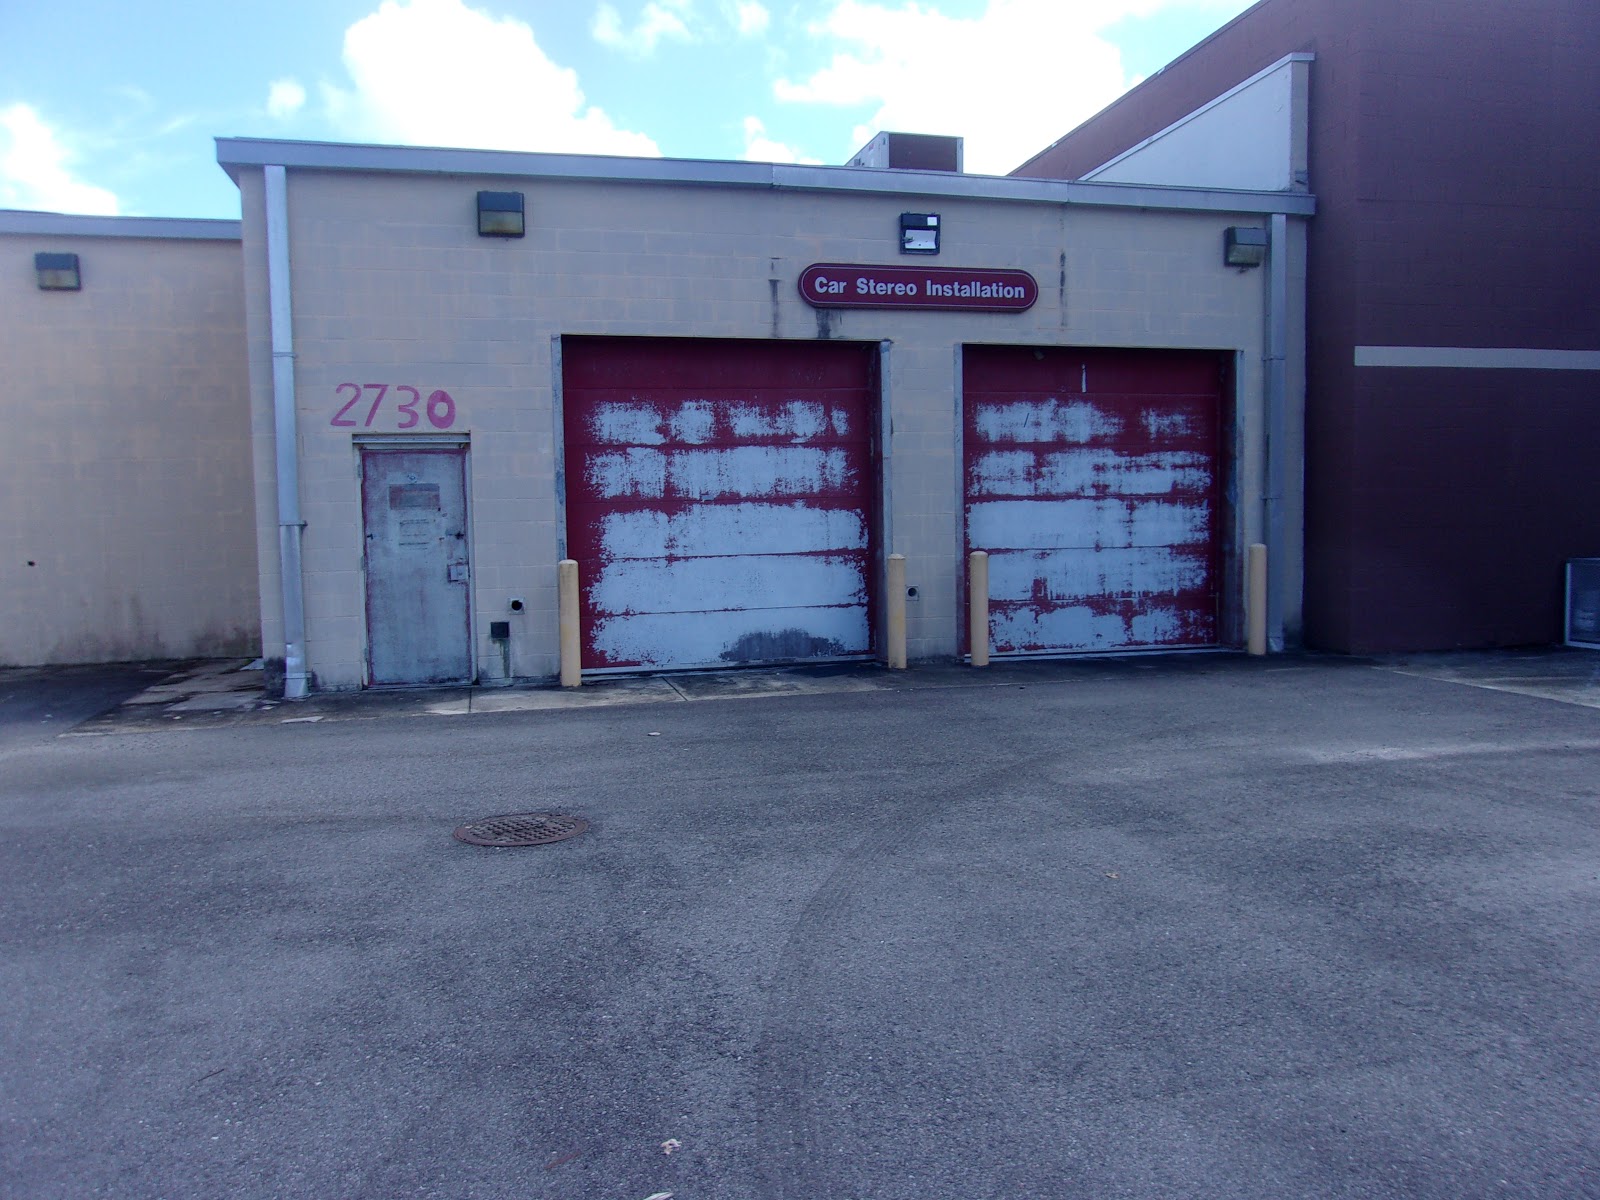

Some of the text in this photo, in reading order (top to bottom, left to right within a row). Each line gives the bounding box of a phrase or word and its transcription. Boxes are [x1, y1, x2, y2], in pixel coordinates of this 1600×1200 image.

[814, 276, 1025, 299] Car Stereo Installation
[330, 383, 456, 429] 2730
